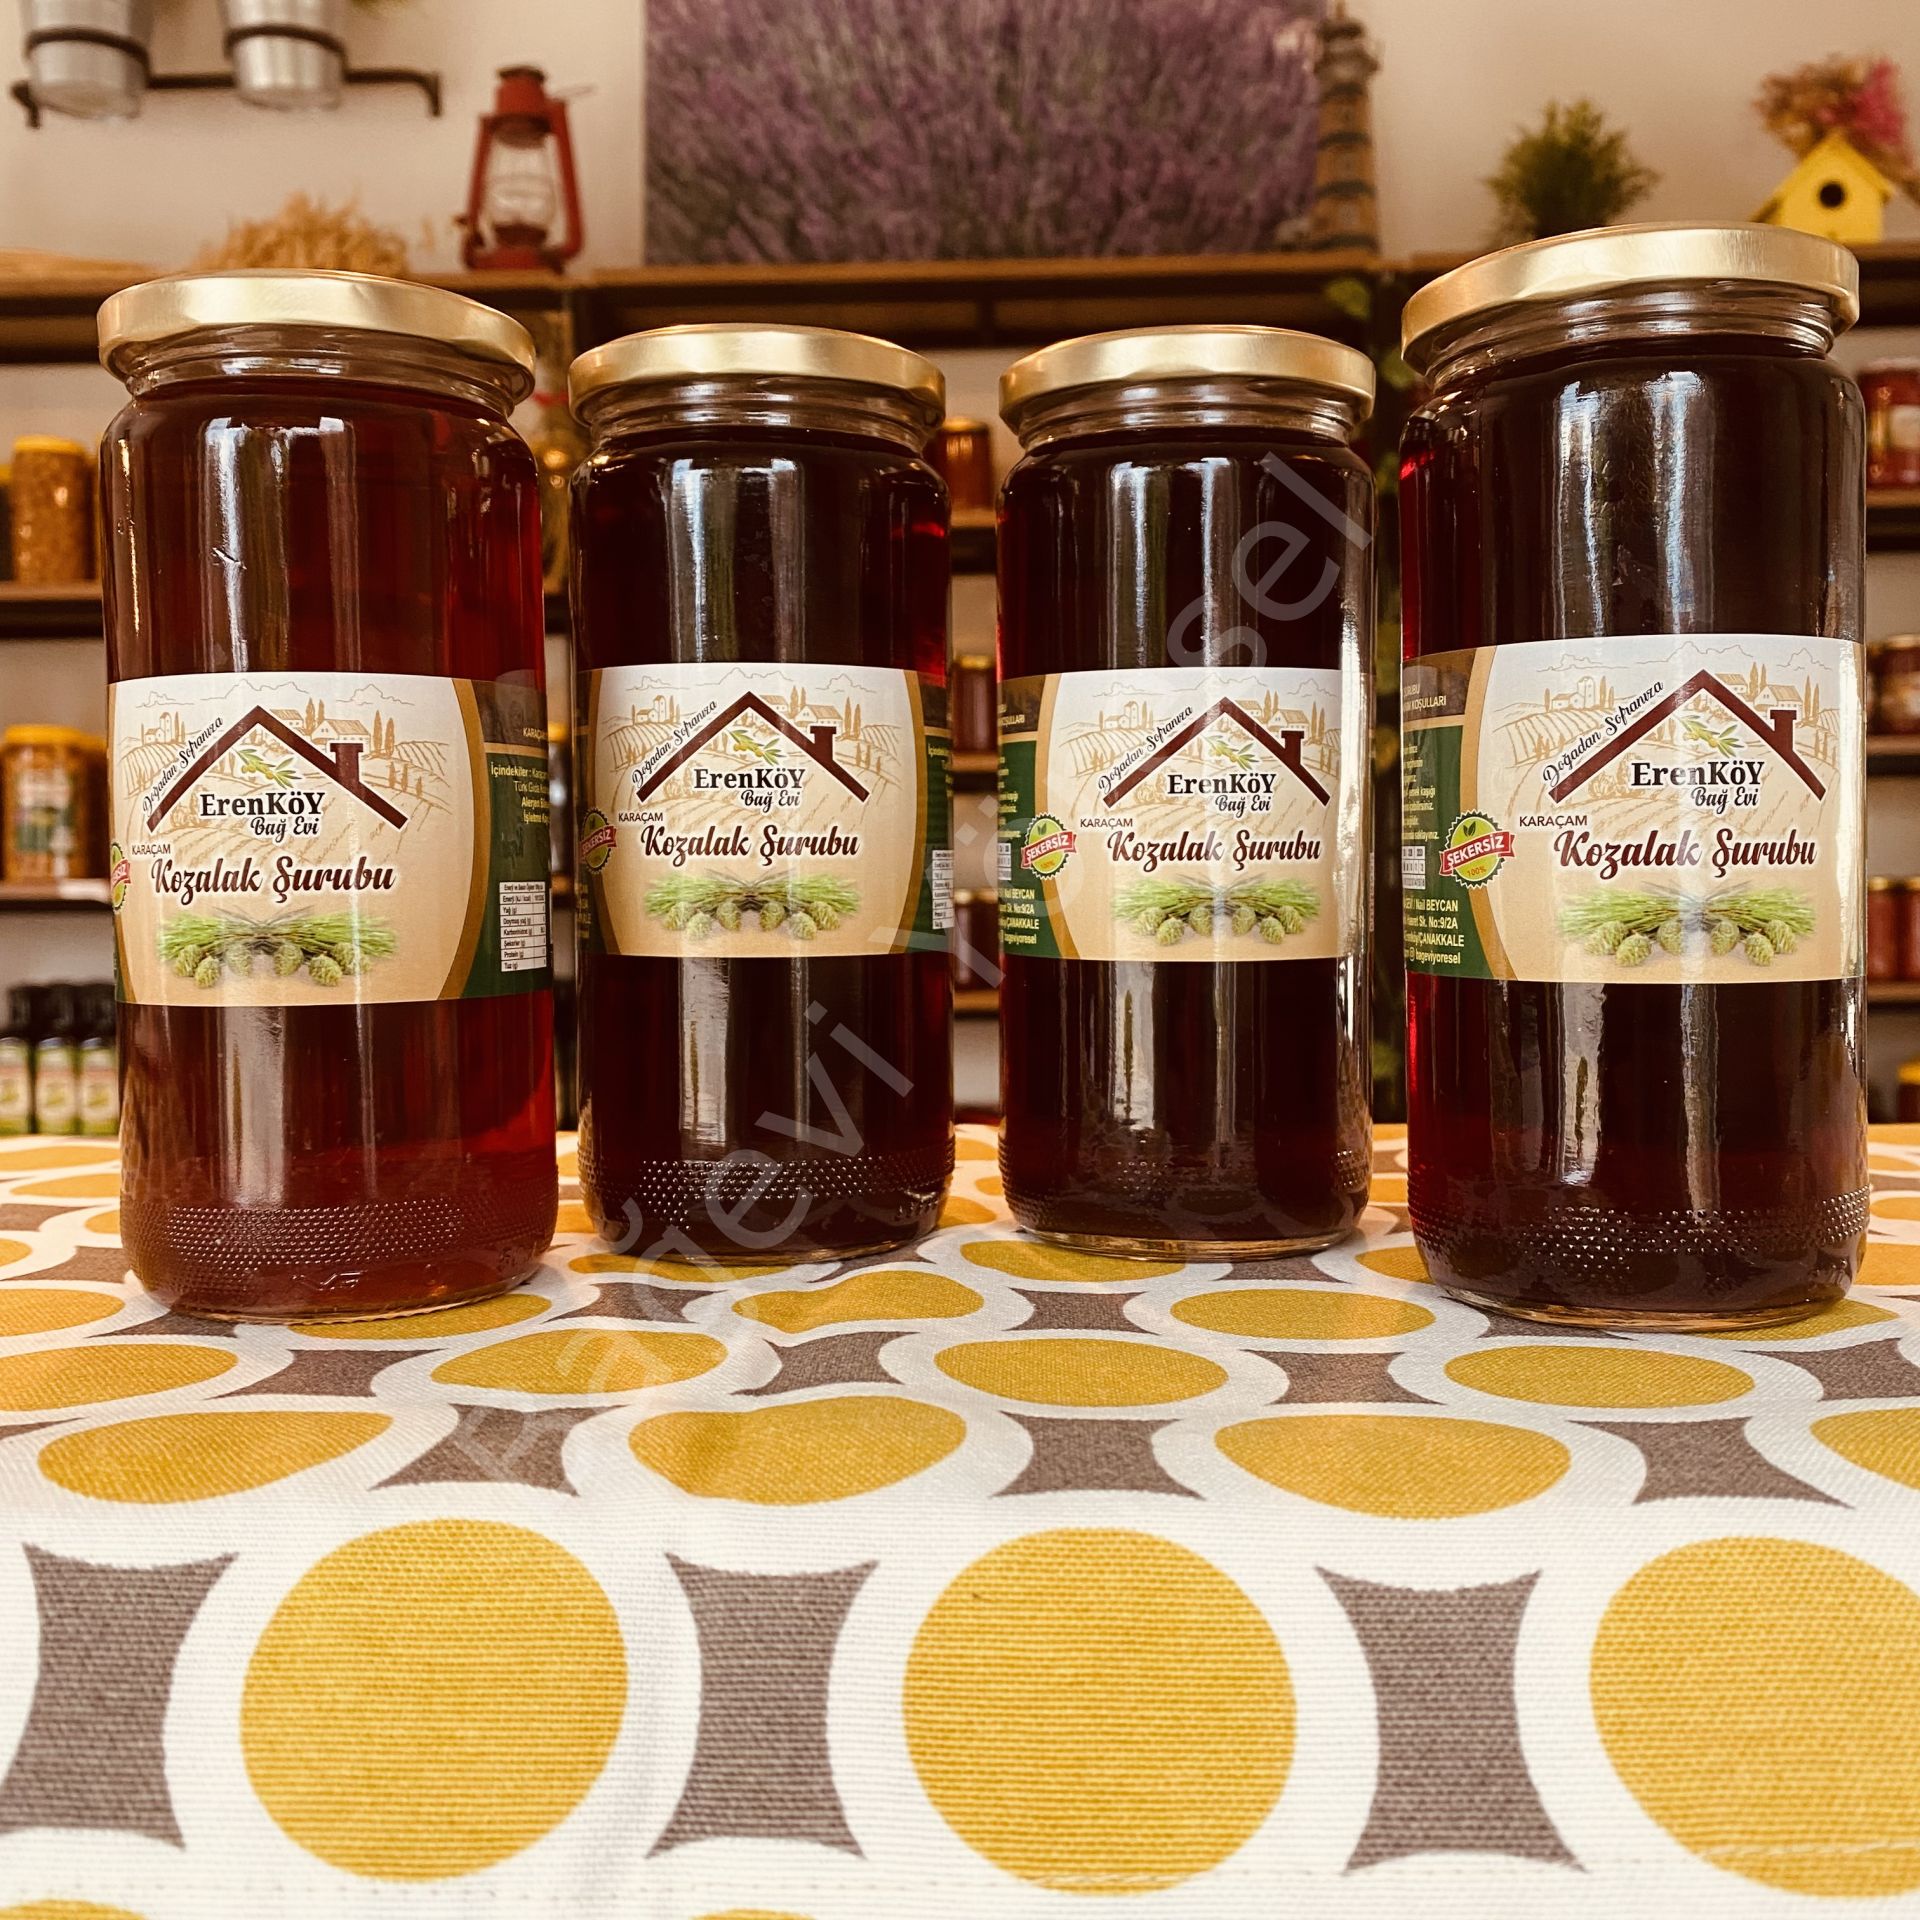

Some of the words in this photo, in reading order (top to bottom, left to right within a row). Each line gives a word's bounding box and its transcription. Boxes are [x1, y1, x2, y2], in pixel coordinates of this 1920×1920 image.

[631, 743, 672, 788] Doğadan
[673, 701, 717, 746] Sofranıza
[1543, 730, 1601, 788] Doğadan
[1605, 680, 1664, 736] Sofranıza
[1099, 750, 1144, 791] Doğadan
[1146, 706, 1193, 752] Sofranıza
[142, 764, 178, 814] Doğadan
[178, 716, 224, 769] Sofranıza
[1631, 760, 1764, 786] ErenKöY
[694, 767, 805, 790] ErenKöY
[1167, 773, 1276, 795] ErenKöY
[200, 791, 325, 817] ErenKöY
[740, 789, 772, 813] Bağ
[778, 790, 801, 807] Evi
[1215, 794, 1246, 818] Bağ
[1250, 795, 1272, 811] Evi
[1691, 786, 1730, 815] Bağ
[1734, 786, 1759, 806] Evi
[250, 816, 287, 843] Bağ
[293, 815, 320, 835] Evi
[618, 812, 663, 823] KARAÇAM
[1080, 818, 1133, 829] KARAÇAM
[1519, 815, 1587, 830] KARAÇAM
[131, 843, 171, 857] KARAÇAM
[640, 825, 751, 867] Kozalak
[760, 824, 860, 867] Şurubu
[1025, 833, 1070, 861] ŞEKERSİZ
[1107, 830, 1224, 873] Kozalak
[1232, 829, 1321, 872] Şurubu
[1447, 834, 1504, 868] ŞEKERSİZ
[1553, 829, 1702, 880] Kozalak
[1712, 828, 1817, 878] Şurubu
[150, 856, 264, 905] Kozalak
[272, 856, 397, 904] Şurubu
[1467, 865, 1487, 878] 100%
[1426, 898, 1459, 911] BEYCAN
[1429, 915, 1459, 929] No:9/2A
